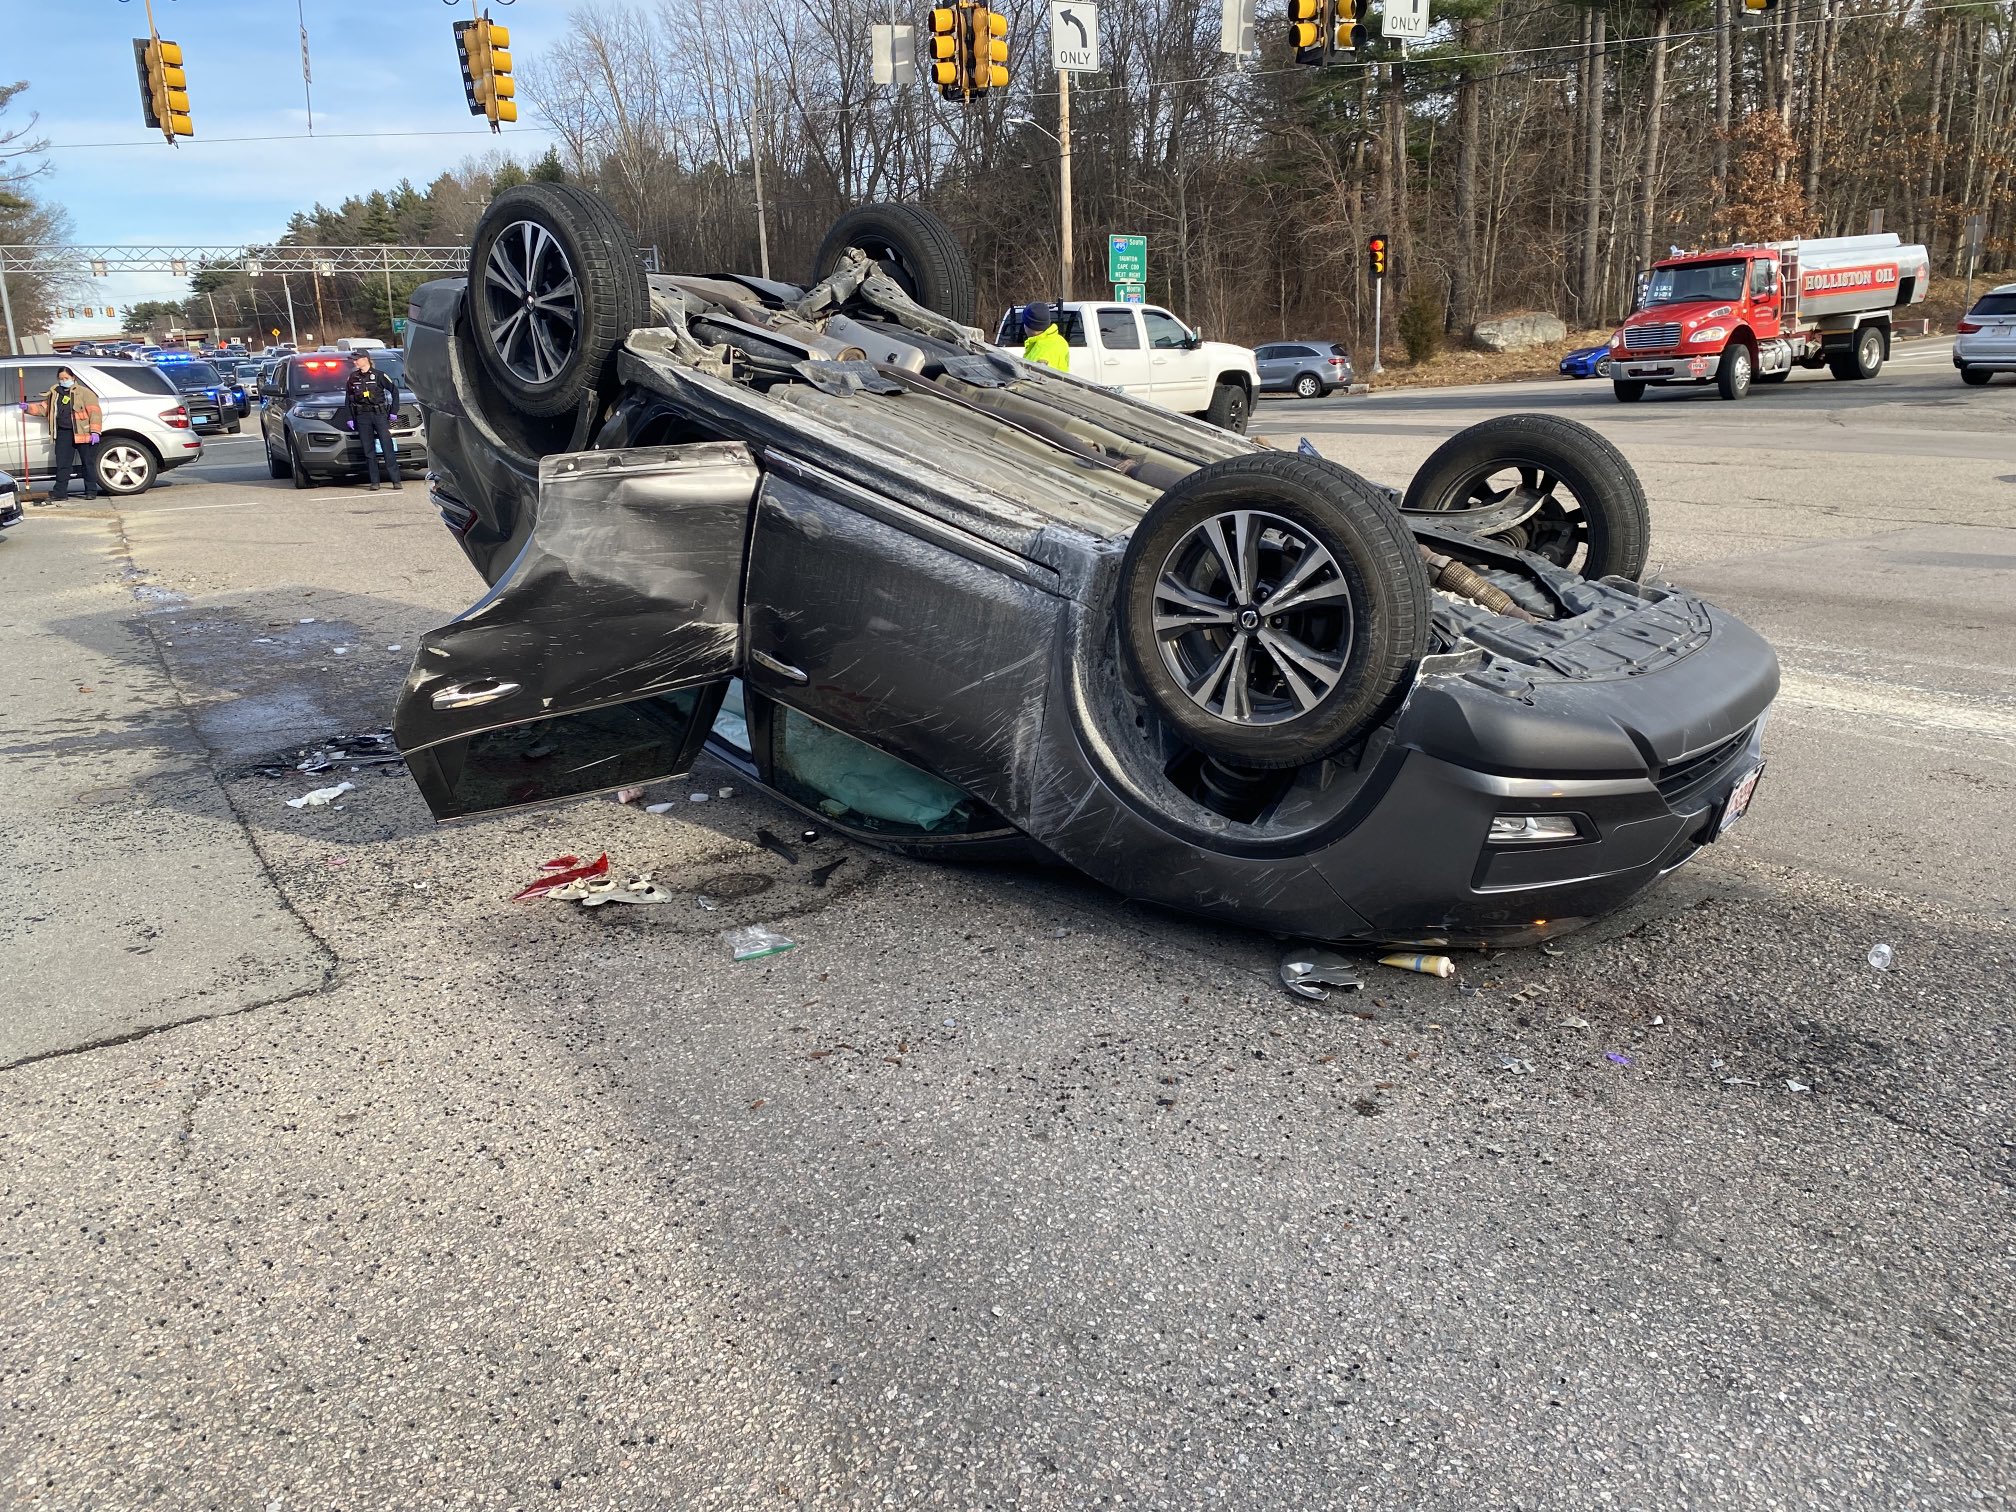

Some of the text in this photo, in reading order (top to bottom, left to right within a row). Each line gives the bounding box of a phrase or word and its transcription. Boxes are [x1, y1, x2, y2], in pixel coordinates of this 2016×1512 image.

[1391, 16, 1420, 31] ONLY
[1060, 50, 1091, 65] ONLY
[1116, 242, 1126, 250] 495
[1804, 267, 1896, 291] HOLLISTON OIL
